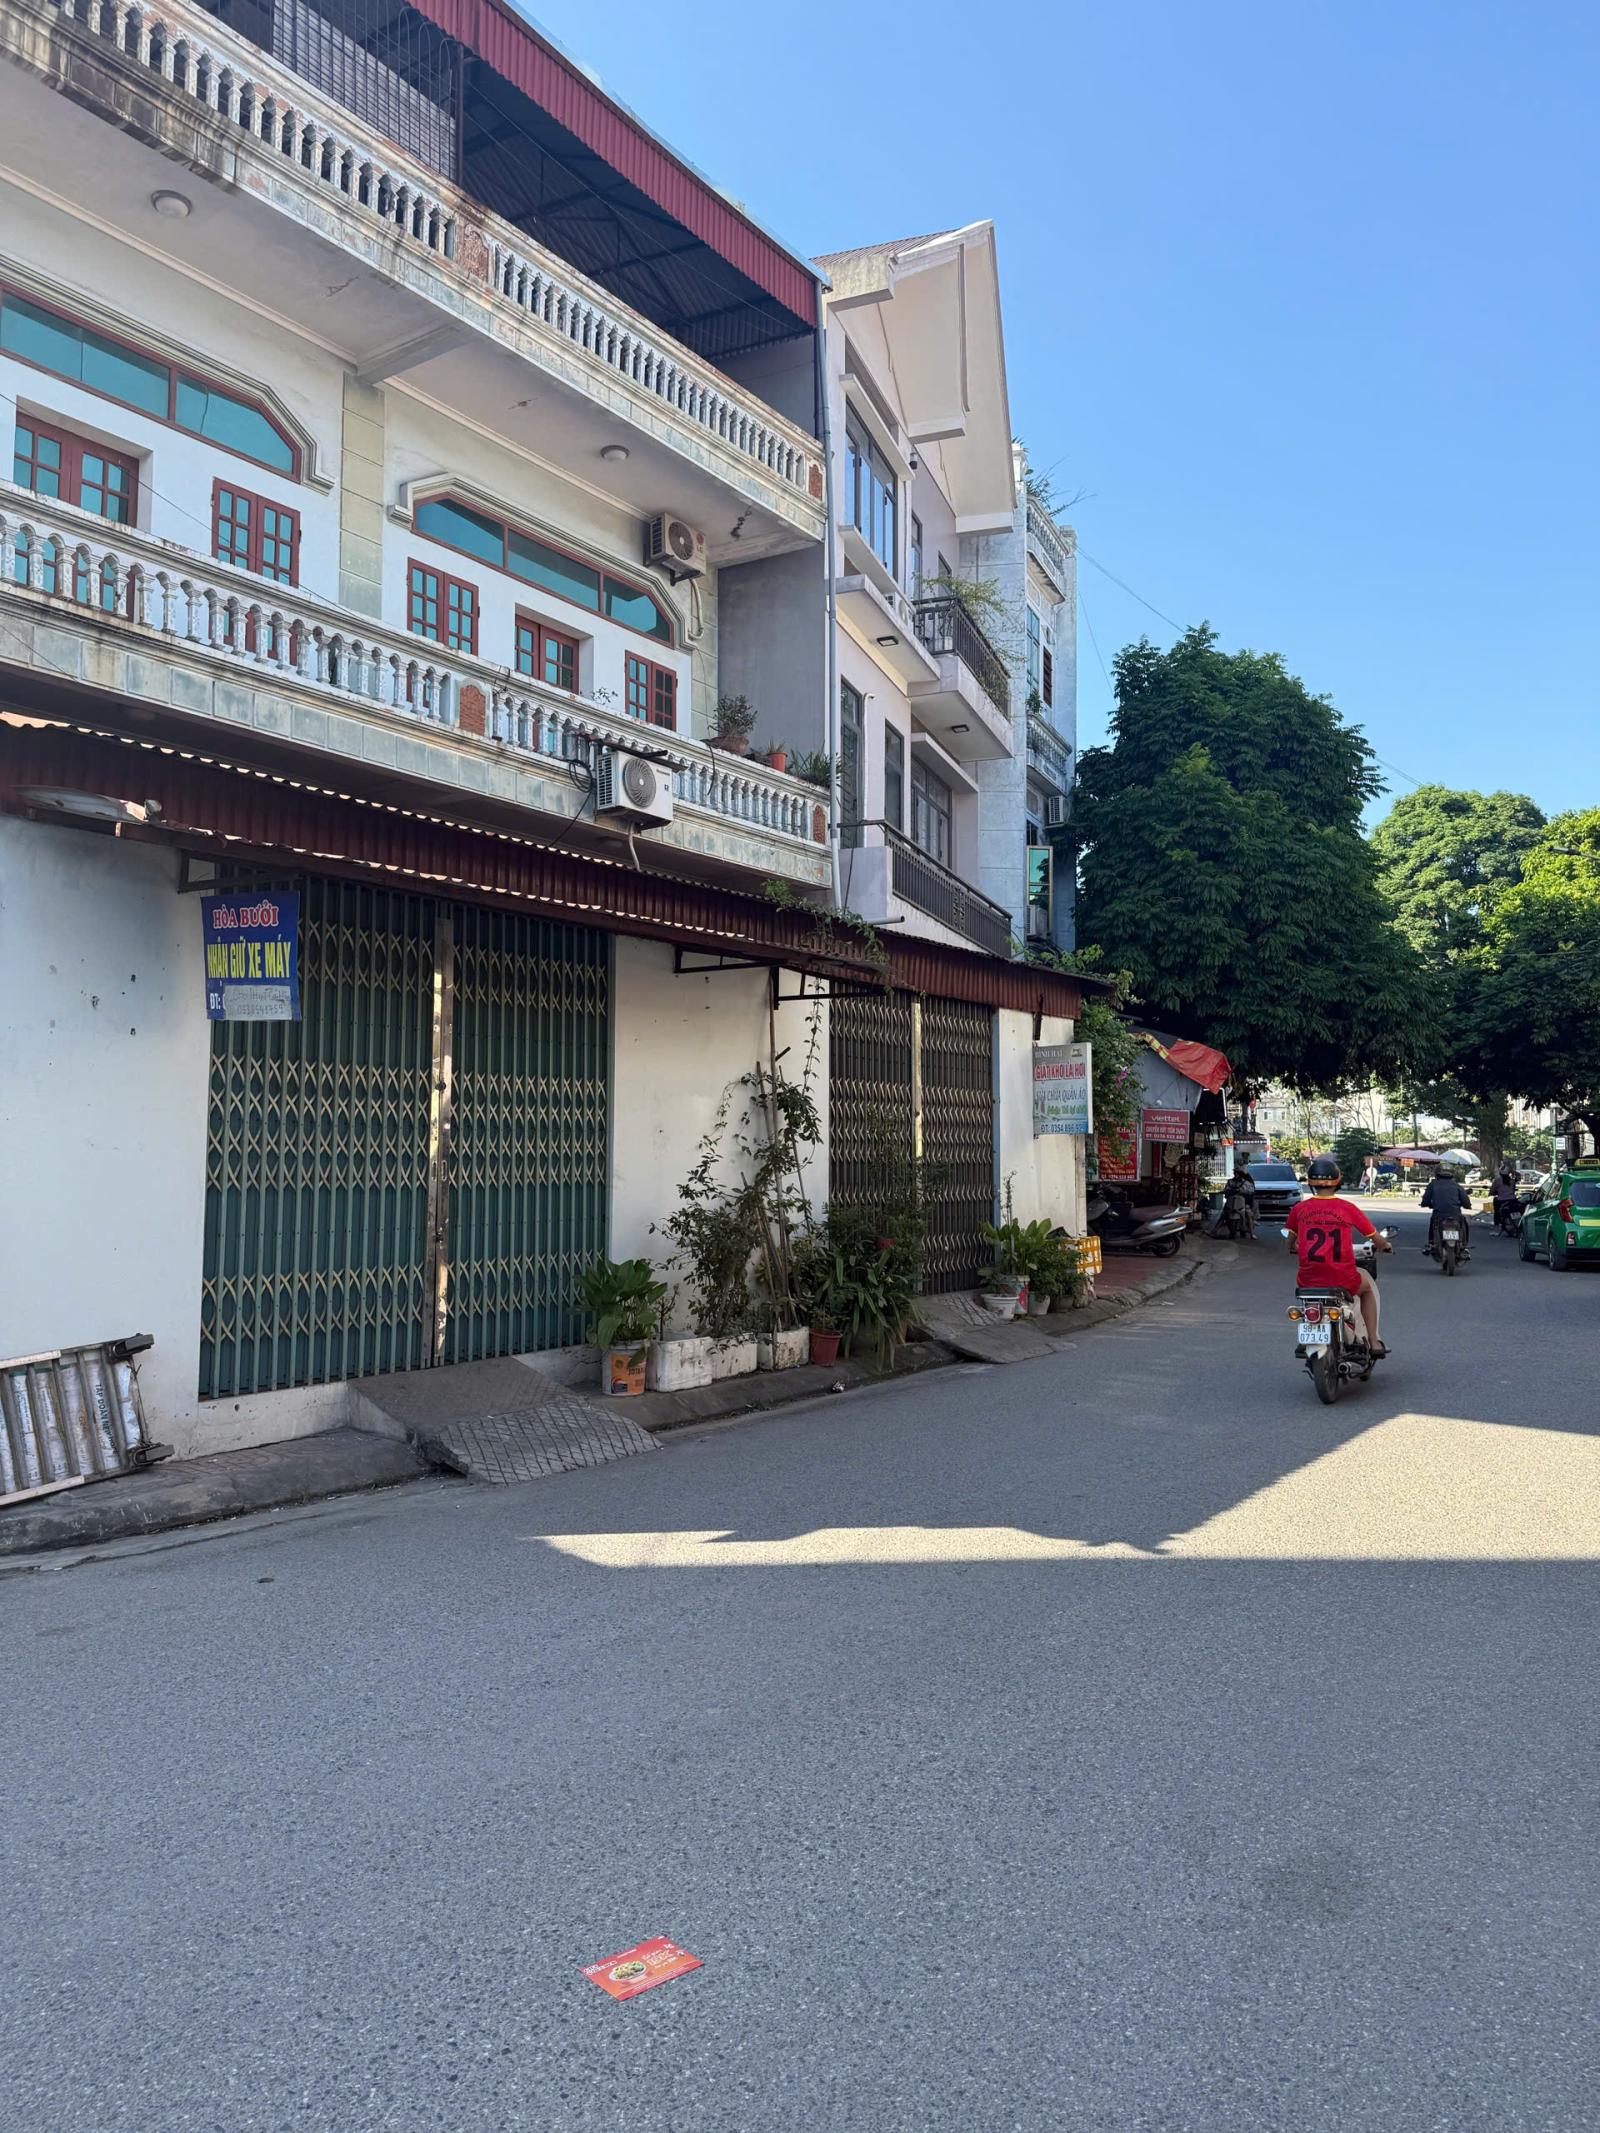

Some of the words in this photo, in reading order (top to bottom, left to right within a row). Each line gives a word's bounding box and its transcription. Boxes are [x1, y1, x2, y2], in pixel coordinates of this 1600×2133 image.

[213, 904, 238, 929] HÒA
[239, 899, 279, 927] BƯỞI
[208, 936, 228, 985] NHẬN
[230, 935, 245, 978] GIỮ
[248, 943, 262, 977] XE
[264, 934, 291, 977] MÁY
[1306, 1228, 1341, 1263] 21
[1303, 1324, 1326, 1333] 98-AA
